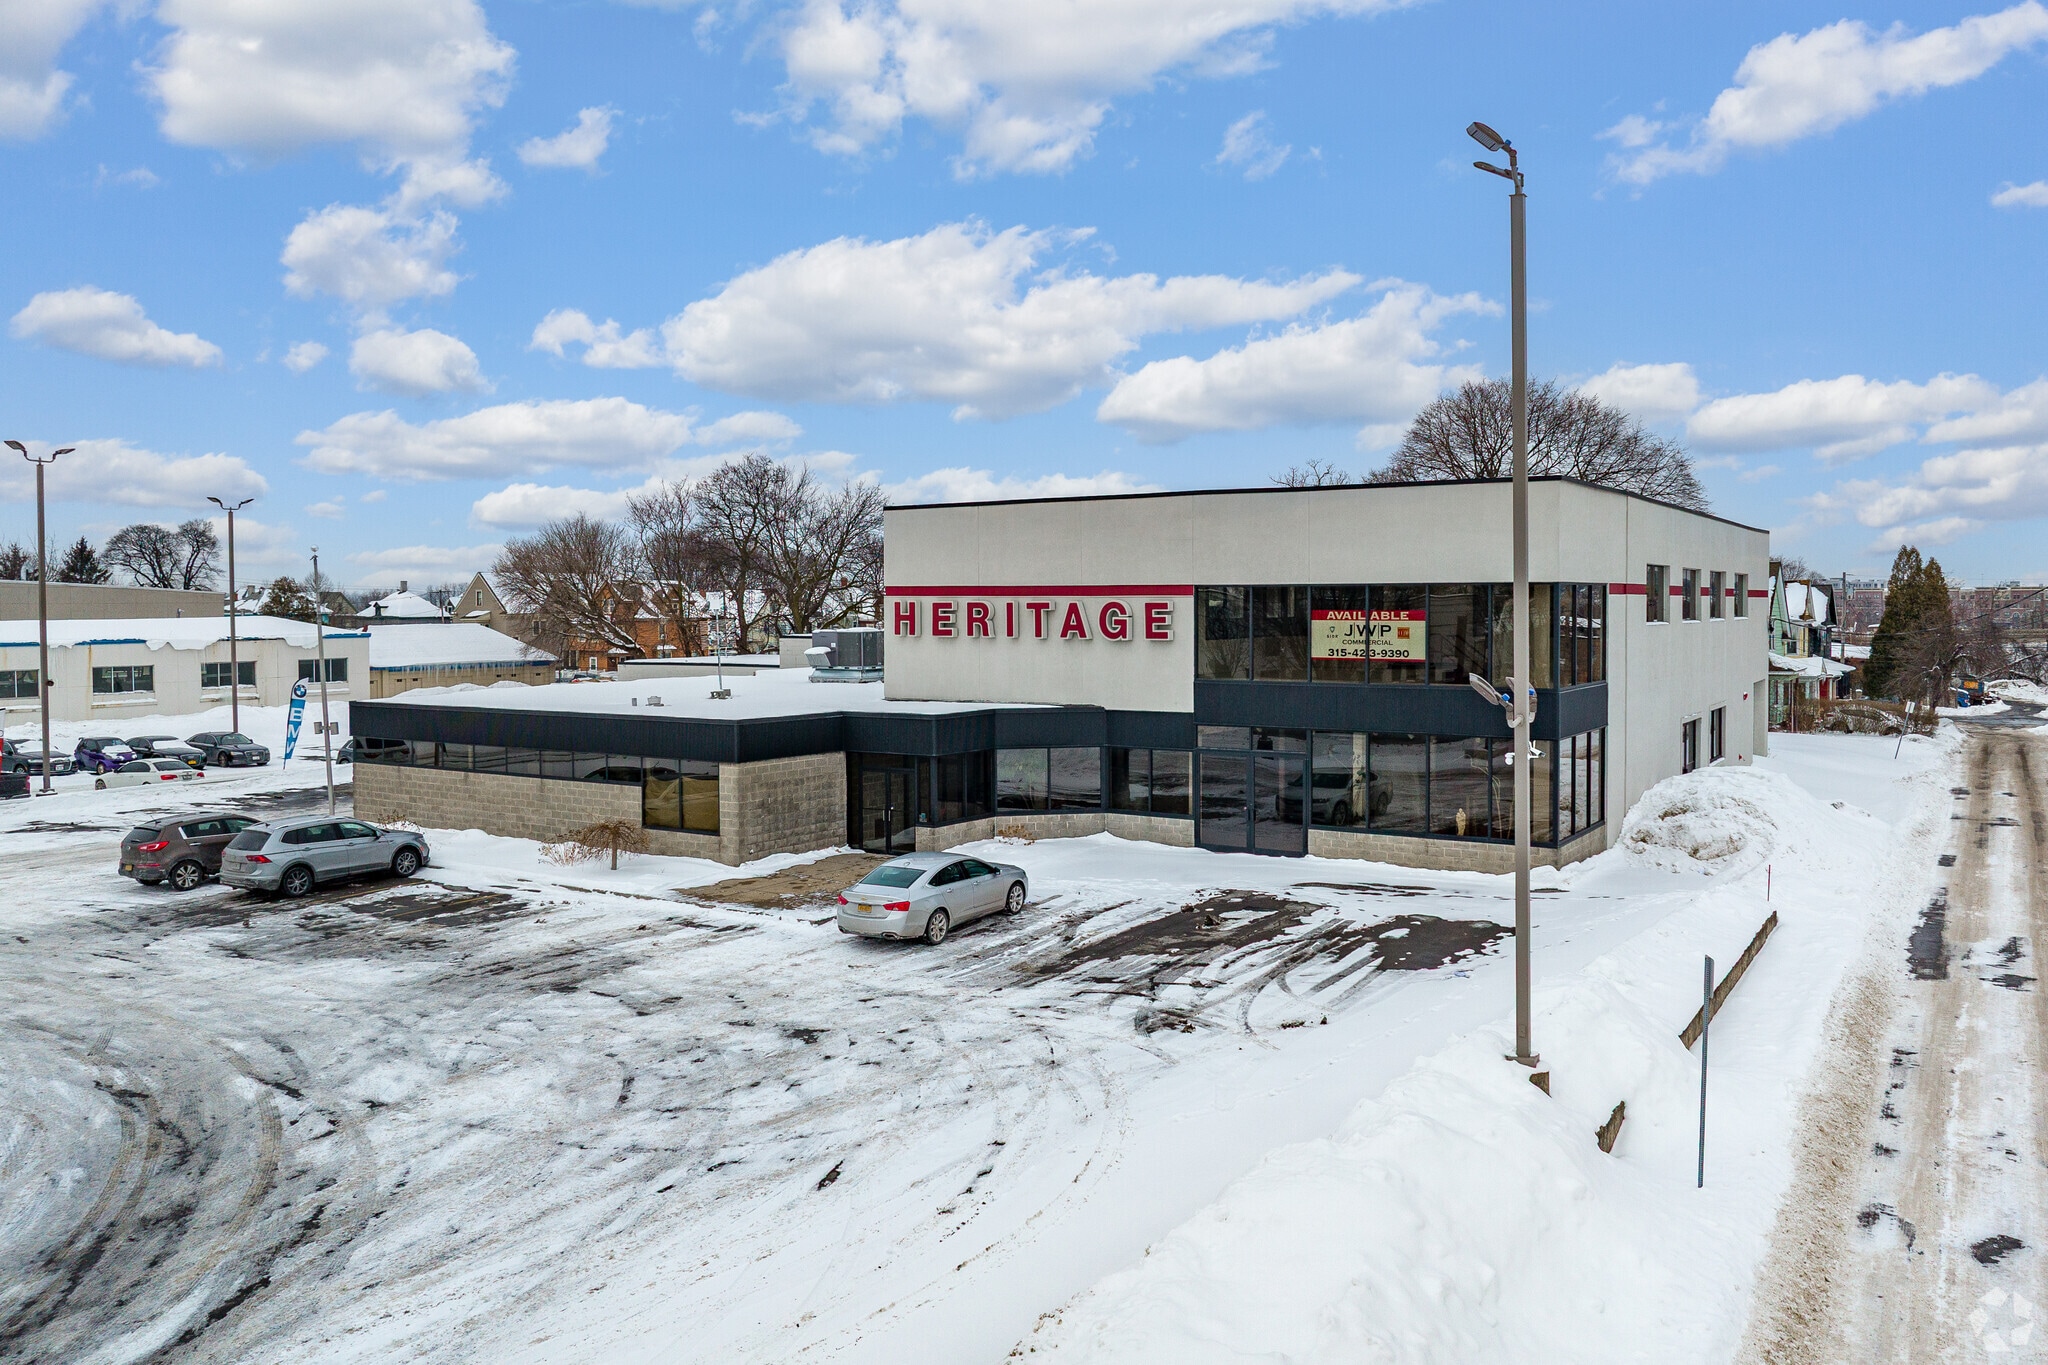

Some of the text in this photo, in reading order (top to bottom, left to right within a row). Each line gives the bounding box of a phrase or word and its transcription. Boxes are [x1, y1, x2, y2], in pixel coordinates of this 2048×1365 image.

[893, 600, 1173, 641] HERITAGE
[1326, 611, 1409, 620] AVAILABLE
[1328, 648, 1410, 658] 315-423-9390
